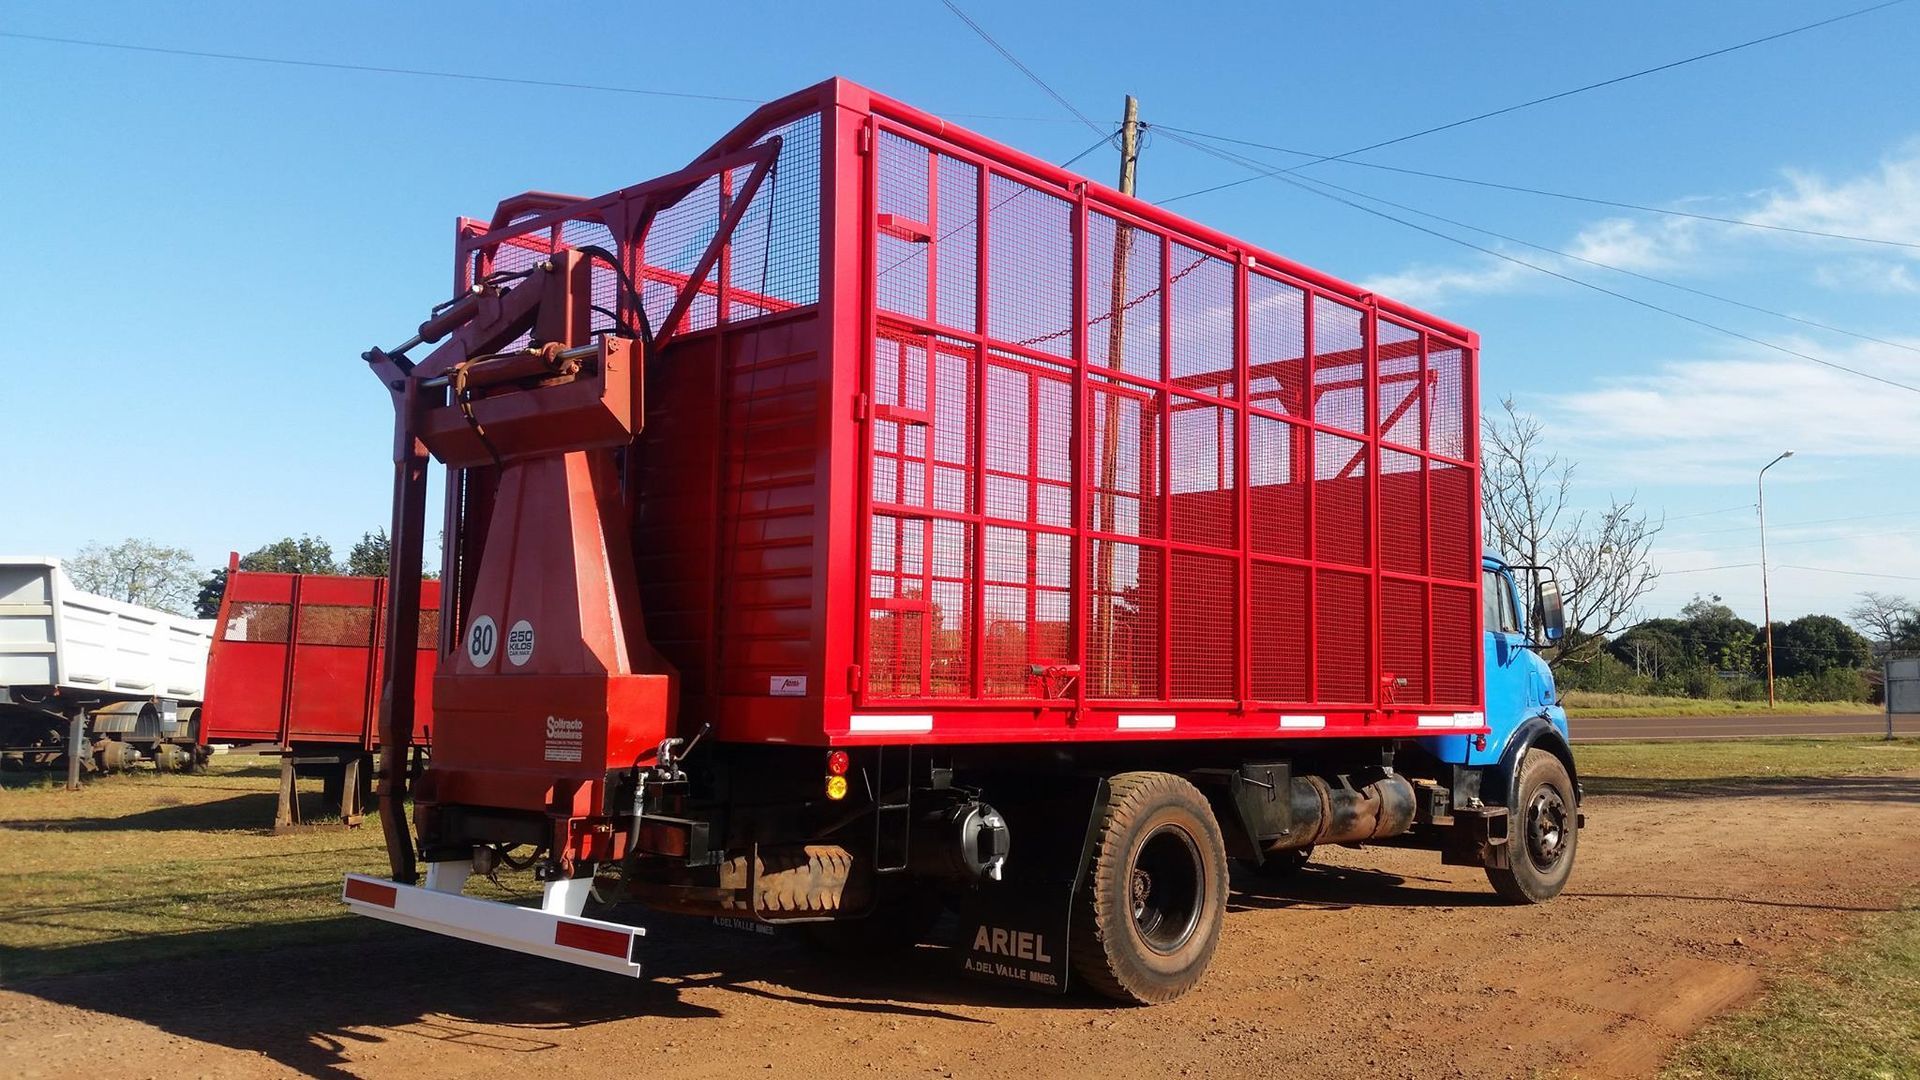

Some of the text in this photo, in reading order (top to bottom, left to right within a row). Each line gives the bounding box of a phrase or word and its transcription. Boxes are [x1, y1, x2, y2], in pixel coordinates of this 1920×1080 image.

[472, 625, 492, 655] 80
[510, 630, 532, 642] 250
[509, 642, 532, 651] KILOS
[973, 925, 1051, 963] ARIEL
[995, 963, 1027, 980] VALLE
